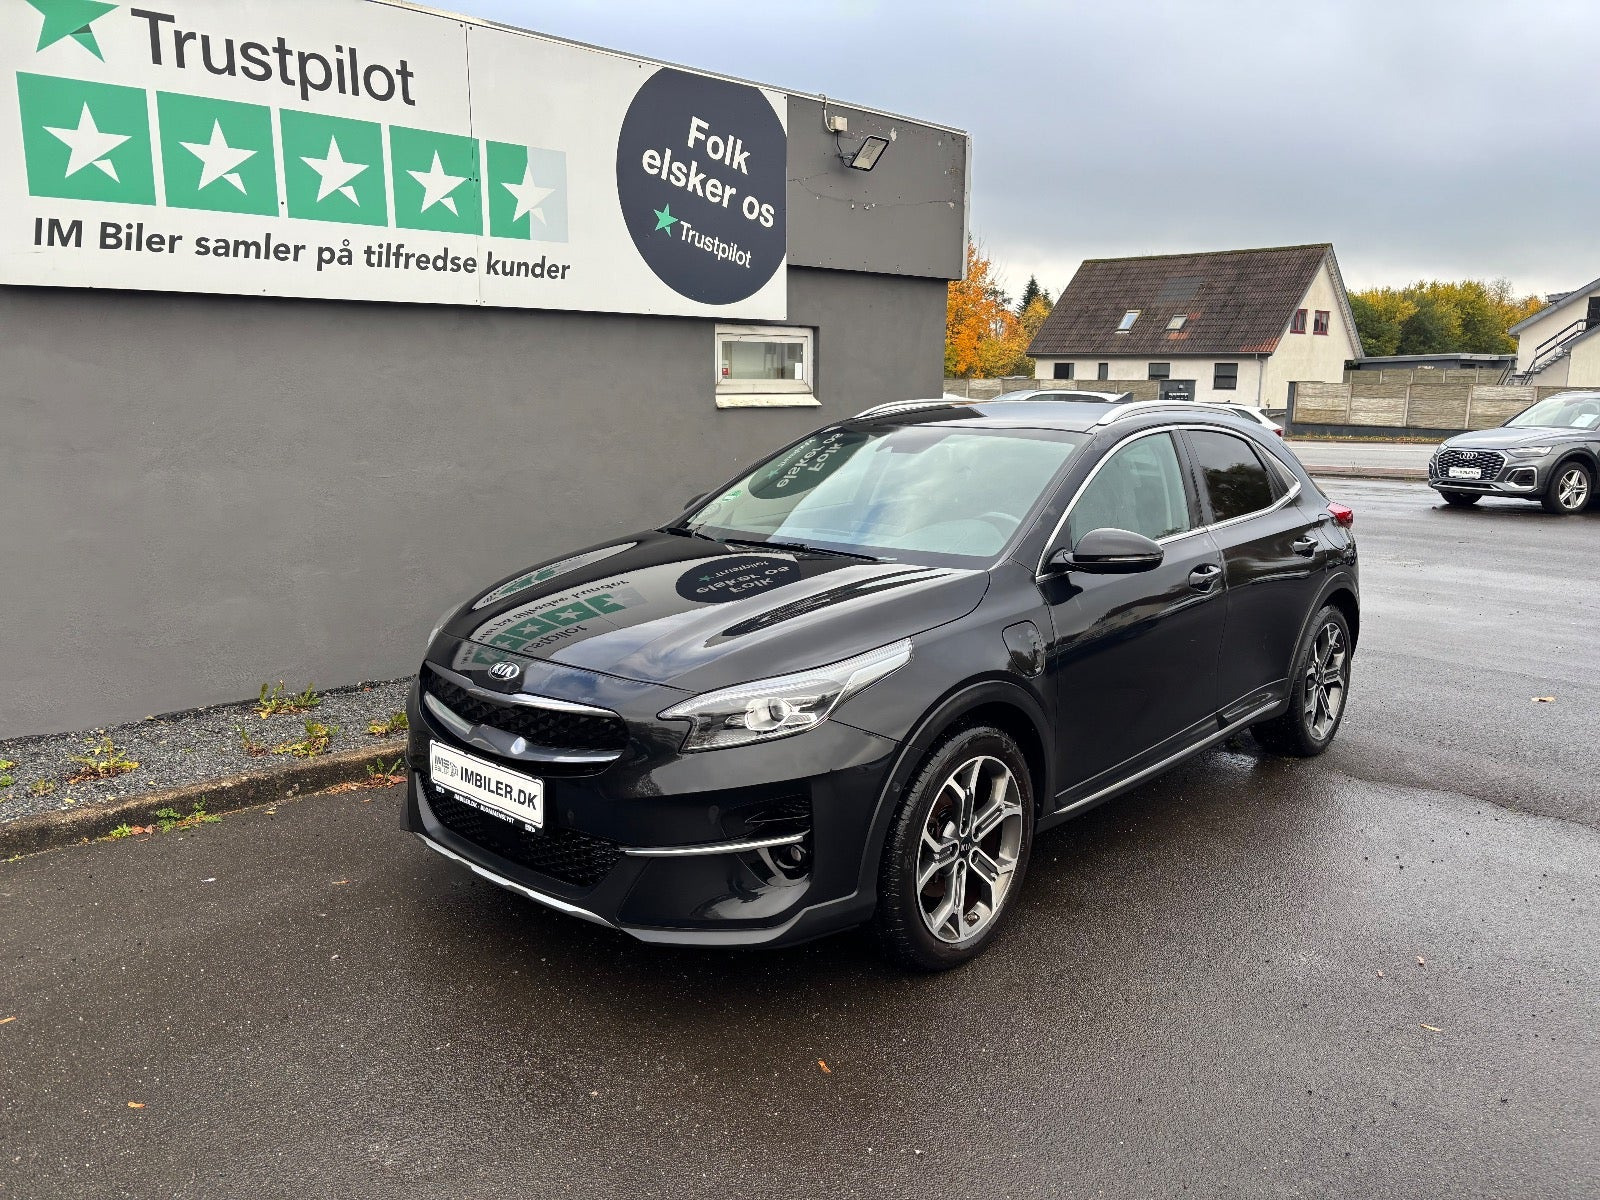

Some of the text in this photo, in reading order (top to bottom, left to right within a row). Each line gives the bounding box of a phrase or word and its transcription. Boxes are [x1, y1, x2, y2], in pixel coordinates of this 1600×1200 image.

[131, 8, 416, 106] Trustpilot
[688, 116, 750, 175] Folk
[642, 148, 775, 228] elsker os
[34, 217, 571, 280] IM Biler samler på tilfredse kunder
[680, 221, 752, 268] Trustpilot
[460, 766, 538, 811] IMBILER.DK
